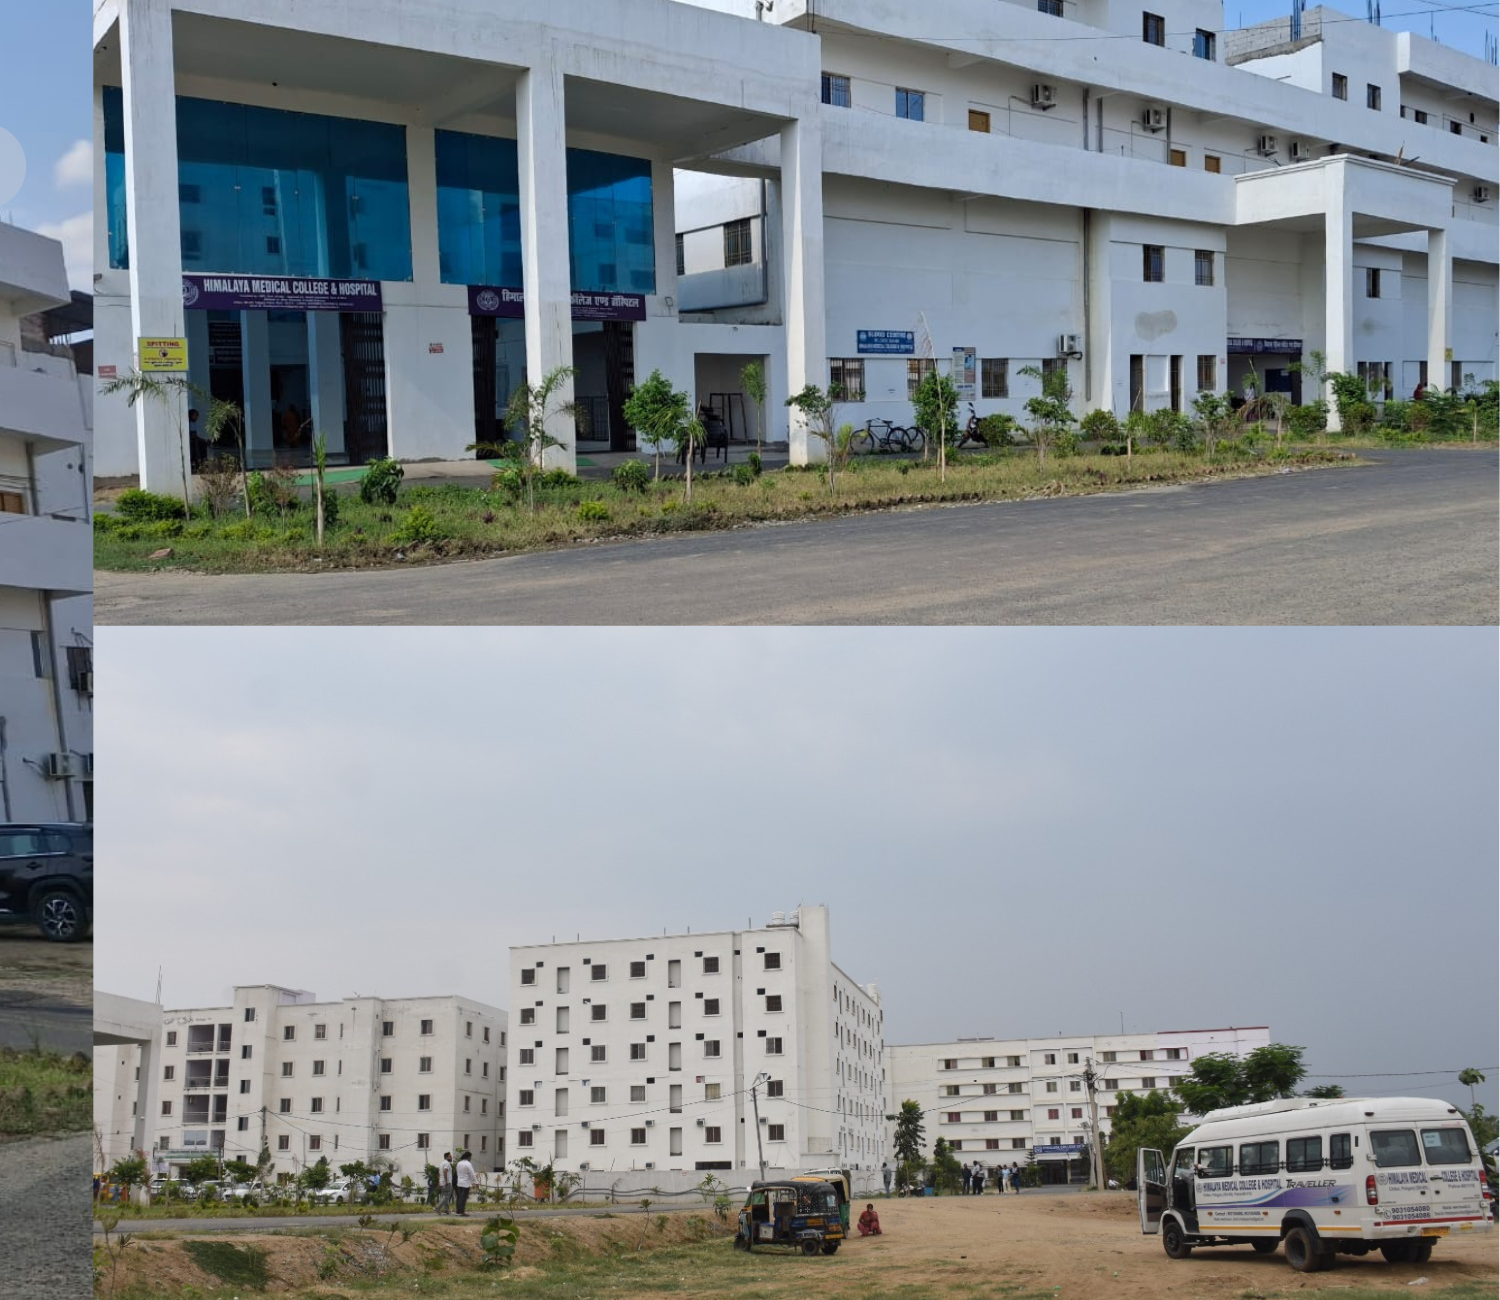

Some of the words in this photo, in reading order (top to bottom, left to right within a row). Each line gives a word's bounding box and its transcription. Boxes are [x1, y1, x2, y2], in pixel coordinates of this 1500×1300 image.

[203, 279, 250, 293] HIMALAYA
[252, 280, 291, 294] MEDICAL
[293, 281, 329, 295] COLLEGE
[330, 282, 338, 295] &
[339, 282, 377, 296] HOSPITAL
[1388, 1172, 1409, 1185] HIMALAYA
[1409, 1171, 1428, 1184] MEDICAL
[1441, 1171, 1458, 1182] COLLEGE
[1461, 1170, 1479, 1182] HOSPITAL
[1203, 1182, 1221, 1192] HIMALAYA
[1222, 1180, 1239, 1191] MEDICAL
[1239, 1179, 1257, 1190] COLLEGE
[1262, 1178, 1282, 1189] HOSPITAL
[1286, 1179, 1337, 1189] TRAVELLER
[1391, 1206, 1431, 1214] 9031054080
[1392, 1212, 1431, 1220] 9031054086
